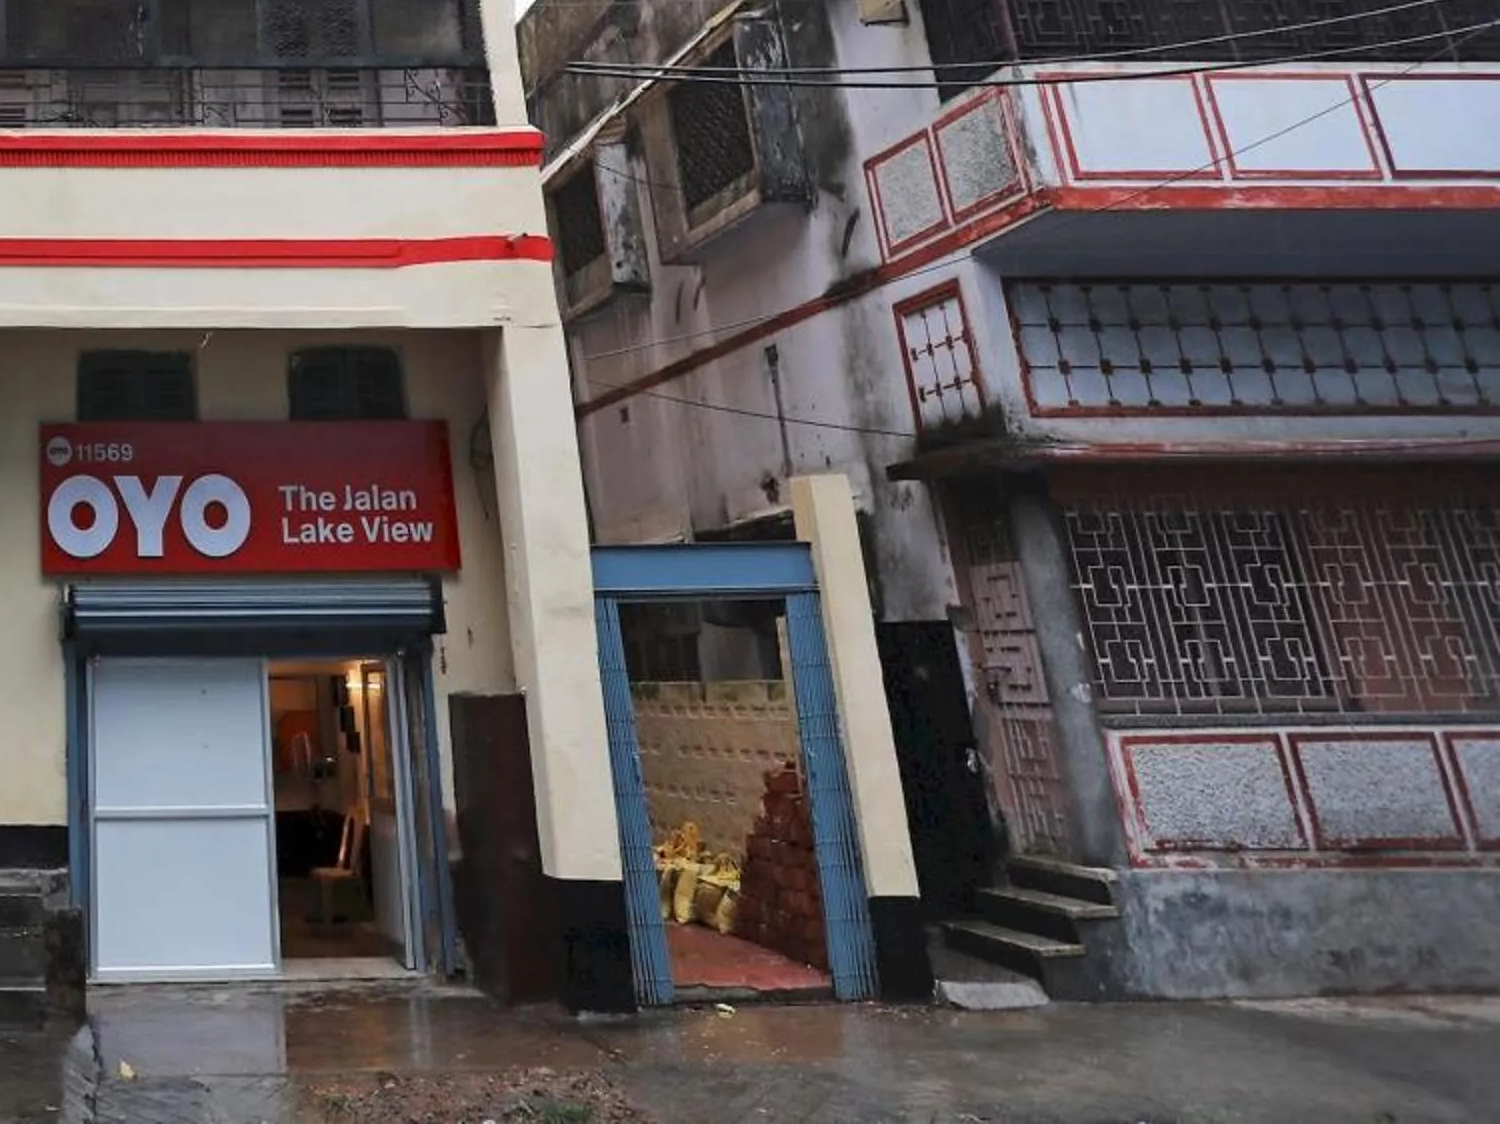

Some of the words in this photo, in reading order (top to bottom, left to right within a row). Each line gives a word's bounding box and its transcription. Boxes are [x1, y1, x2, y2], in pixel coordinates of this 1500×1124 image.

[77, 443, 133, 462] 11569
[279, 485, 336, 512] The
[344, 484, 416, 512] Jalan
[47, 474, 251, 558] OYO
[282, 516, 354, 543] Lake
[361, 516, 433, 543] View
